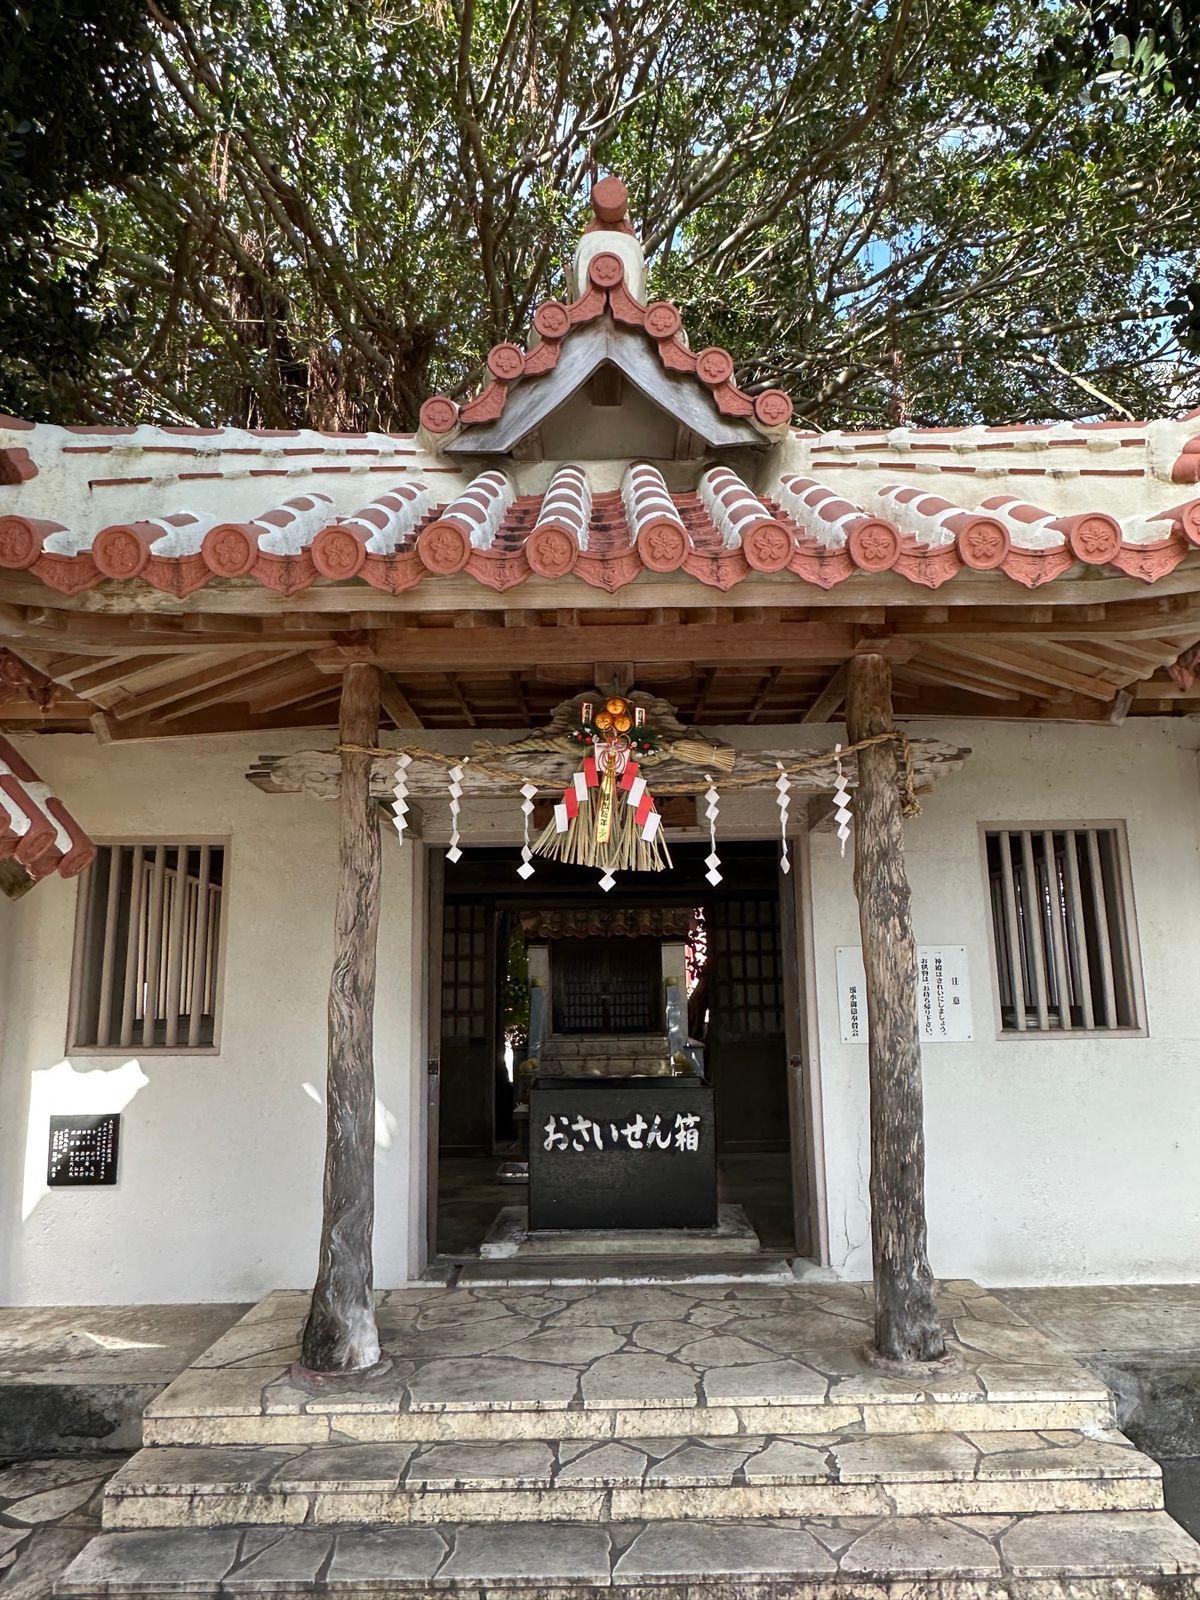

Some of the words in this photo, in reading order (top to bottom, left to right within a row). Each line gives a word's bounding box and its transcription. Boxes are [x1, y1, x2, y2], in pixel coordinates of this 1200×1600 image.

[952, 976, 960, 1005] 注意
[543, 1112, 701, 1151] おさいせん箱
